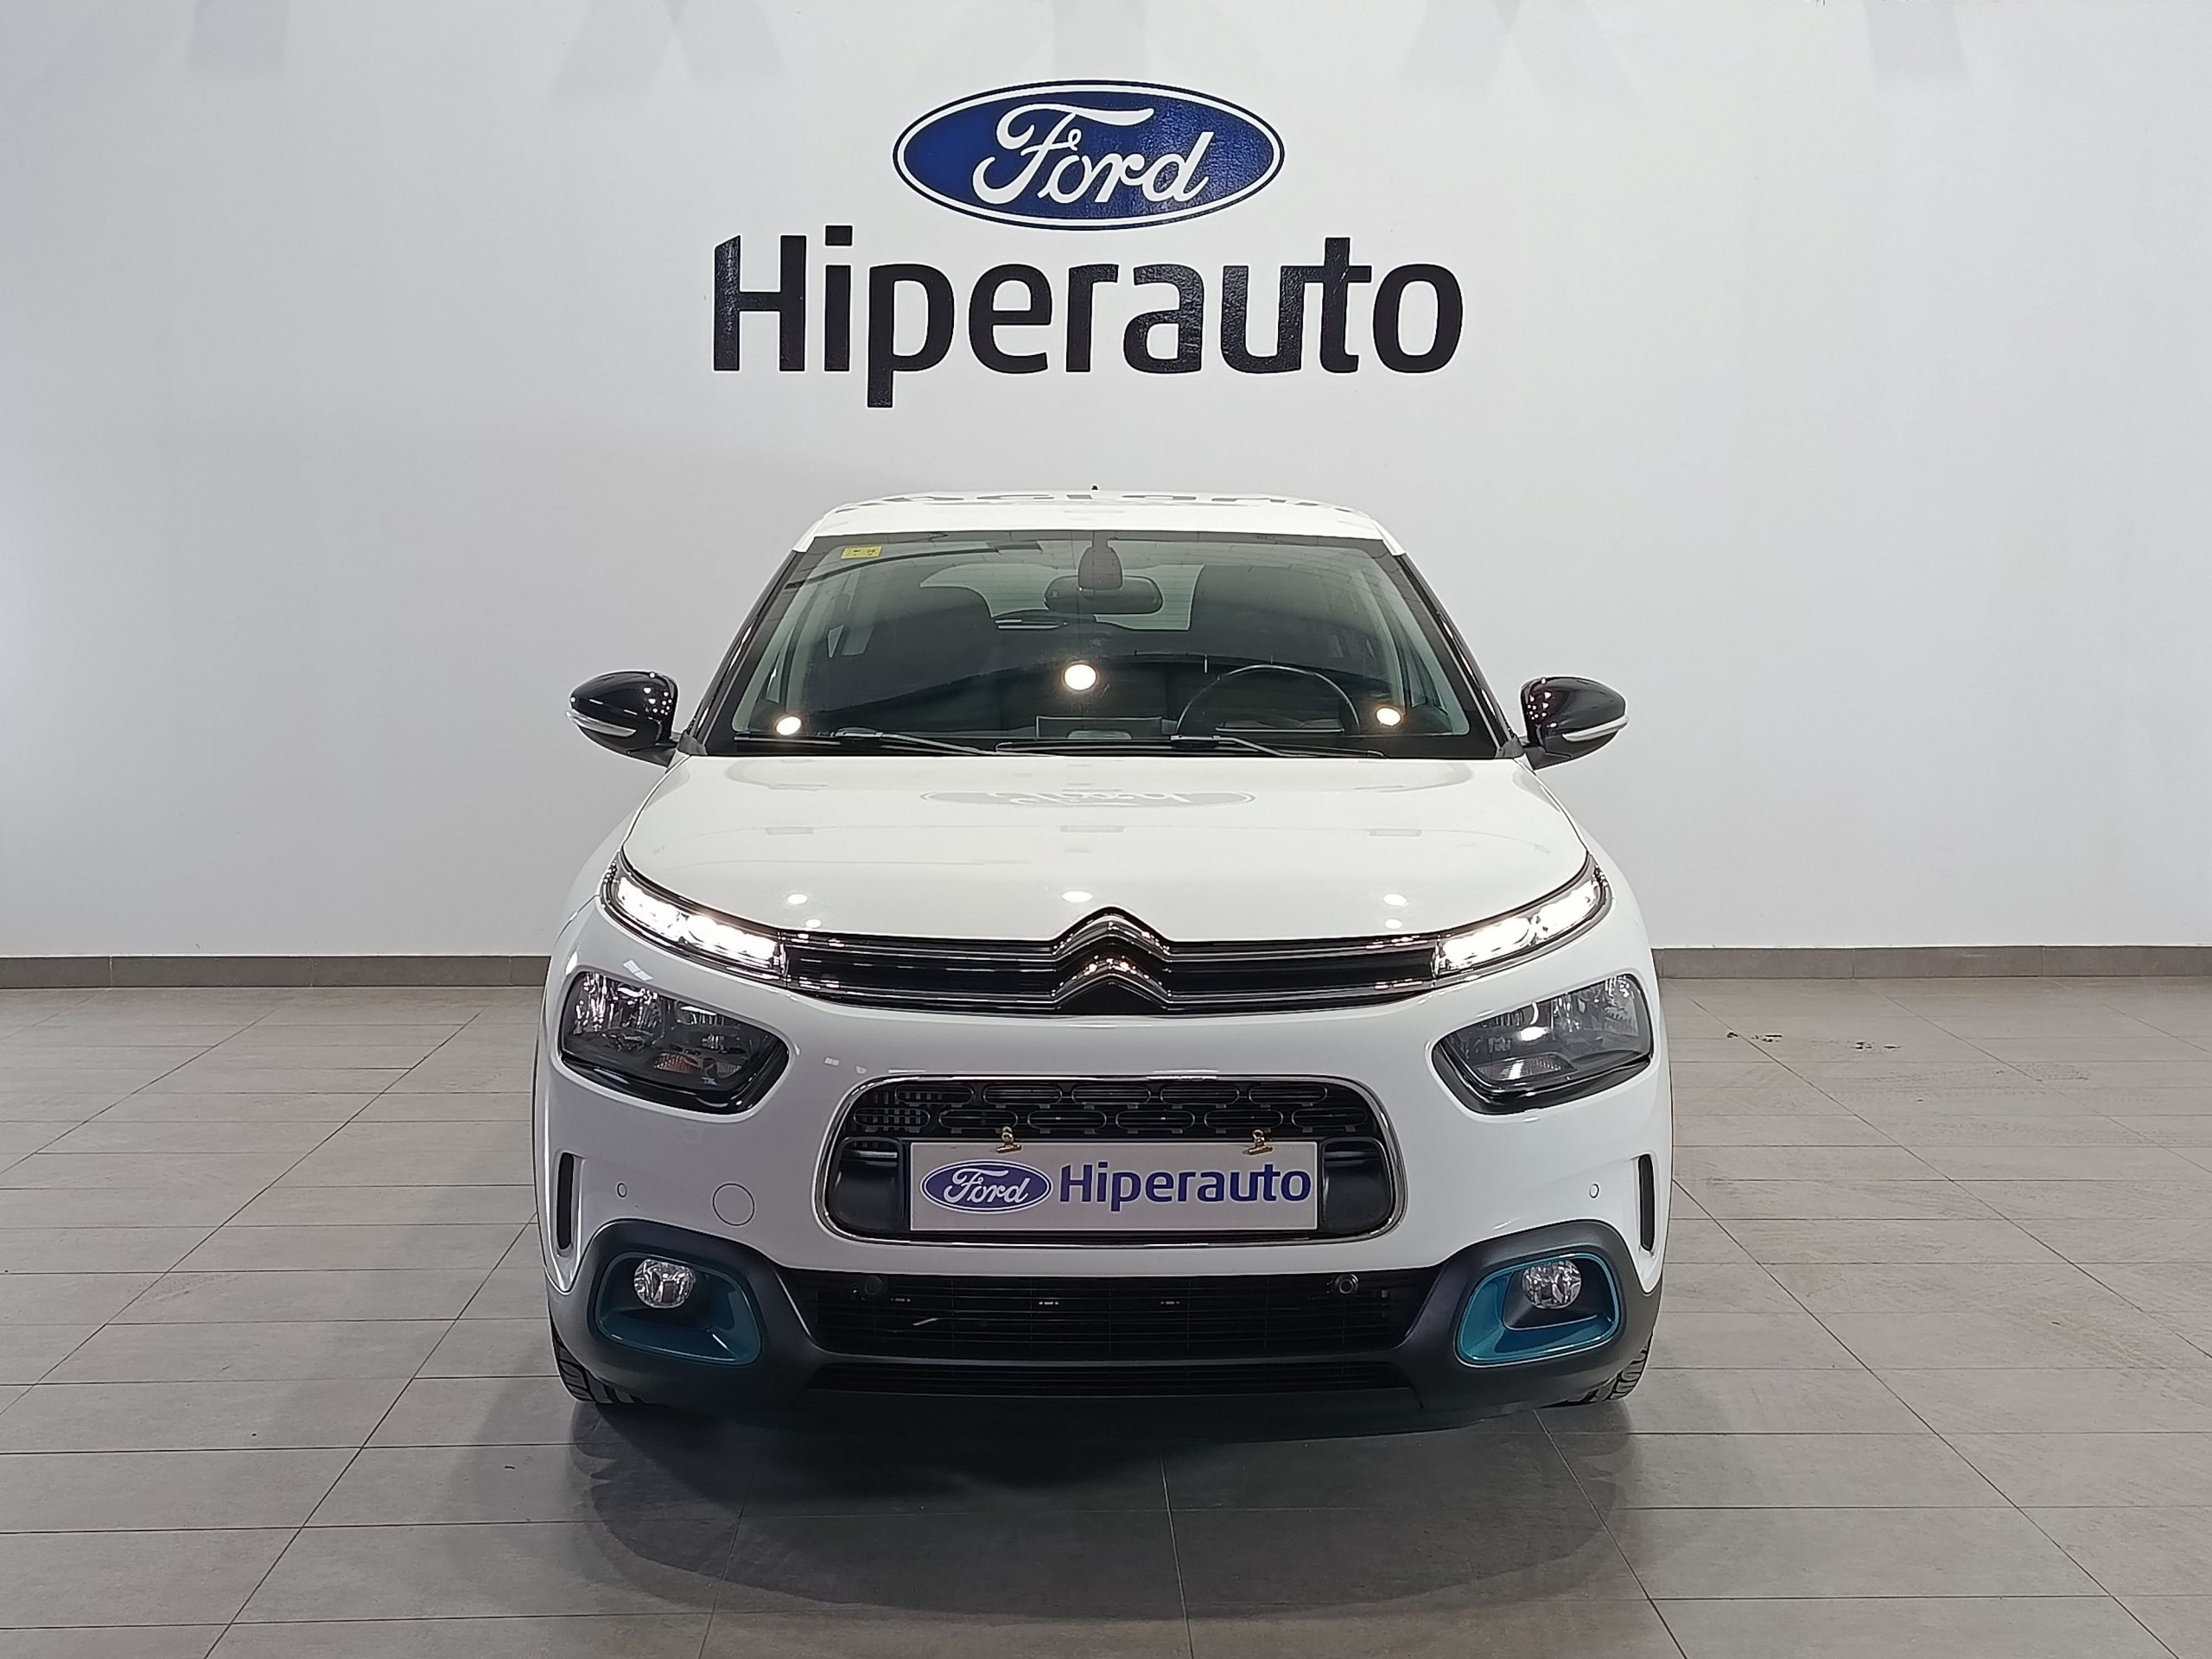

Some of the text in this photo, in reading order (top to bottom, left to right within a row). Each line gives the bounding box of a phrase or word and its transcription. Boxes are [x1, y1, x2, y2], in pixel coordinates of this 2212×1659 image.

[973, 103, 1215, 205] Ford
[714, 225, 1464, 409] Hiperauto
[943, 1161, 1312, 1212] Ford Hiperauto
